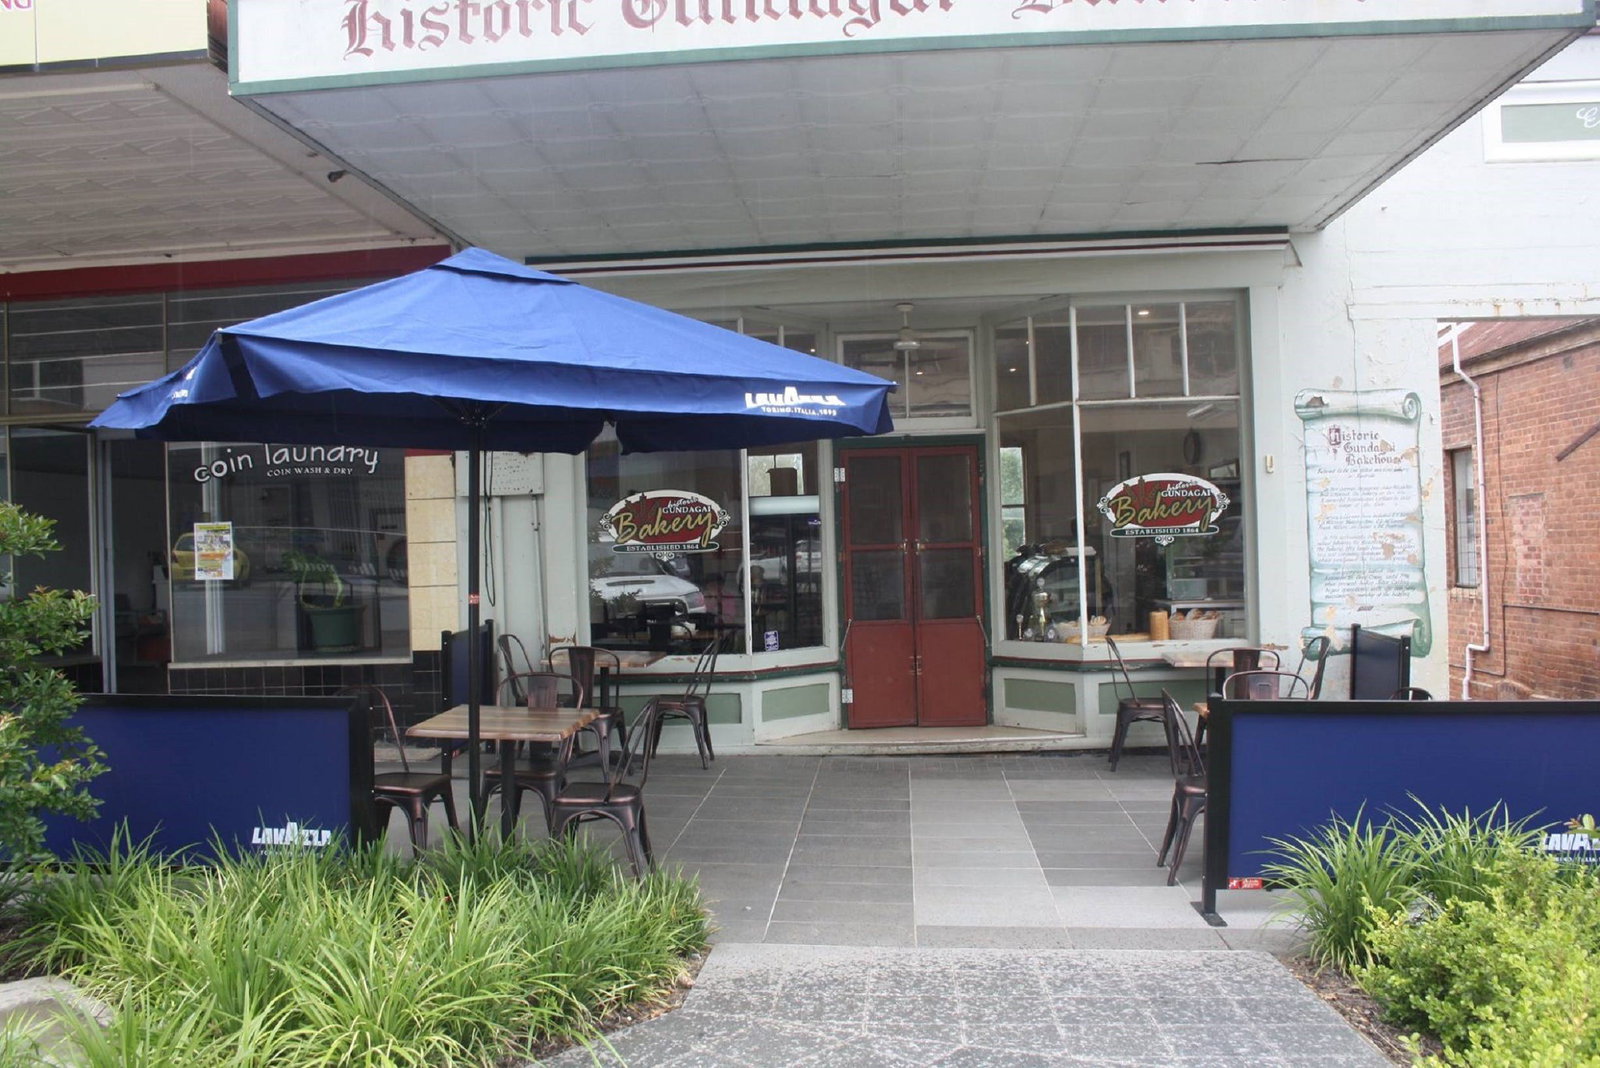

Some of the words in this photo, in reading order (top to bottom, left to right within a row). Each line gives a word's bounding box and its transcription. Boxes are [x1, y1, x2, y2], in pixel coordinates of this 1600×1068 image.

[194, 448, 253, 482] coin
[265, 443, 378, 474] laundry
[267, 468, 291, 477] COIN
[333, 467, 353, 475] DRY
[1161, 489, 1211, 498] GUNDAGAI
[662, 506, 712, 514] GUNDAGAI
[1109, 492, 1213, 532] Bakery
[611, 508, 713, 548] Bakery
[626, 544, 681, 552] ESTABLISHED
